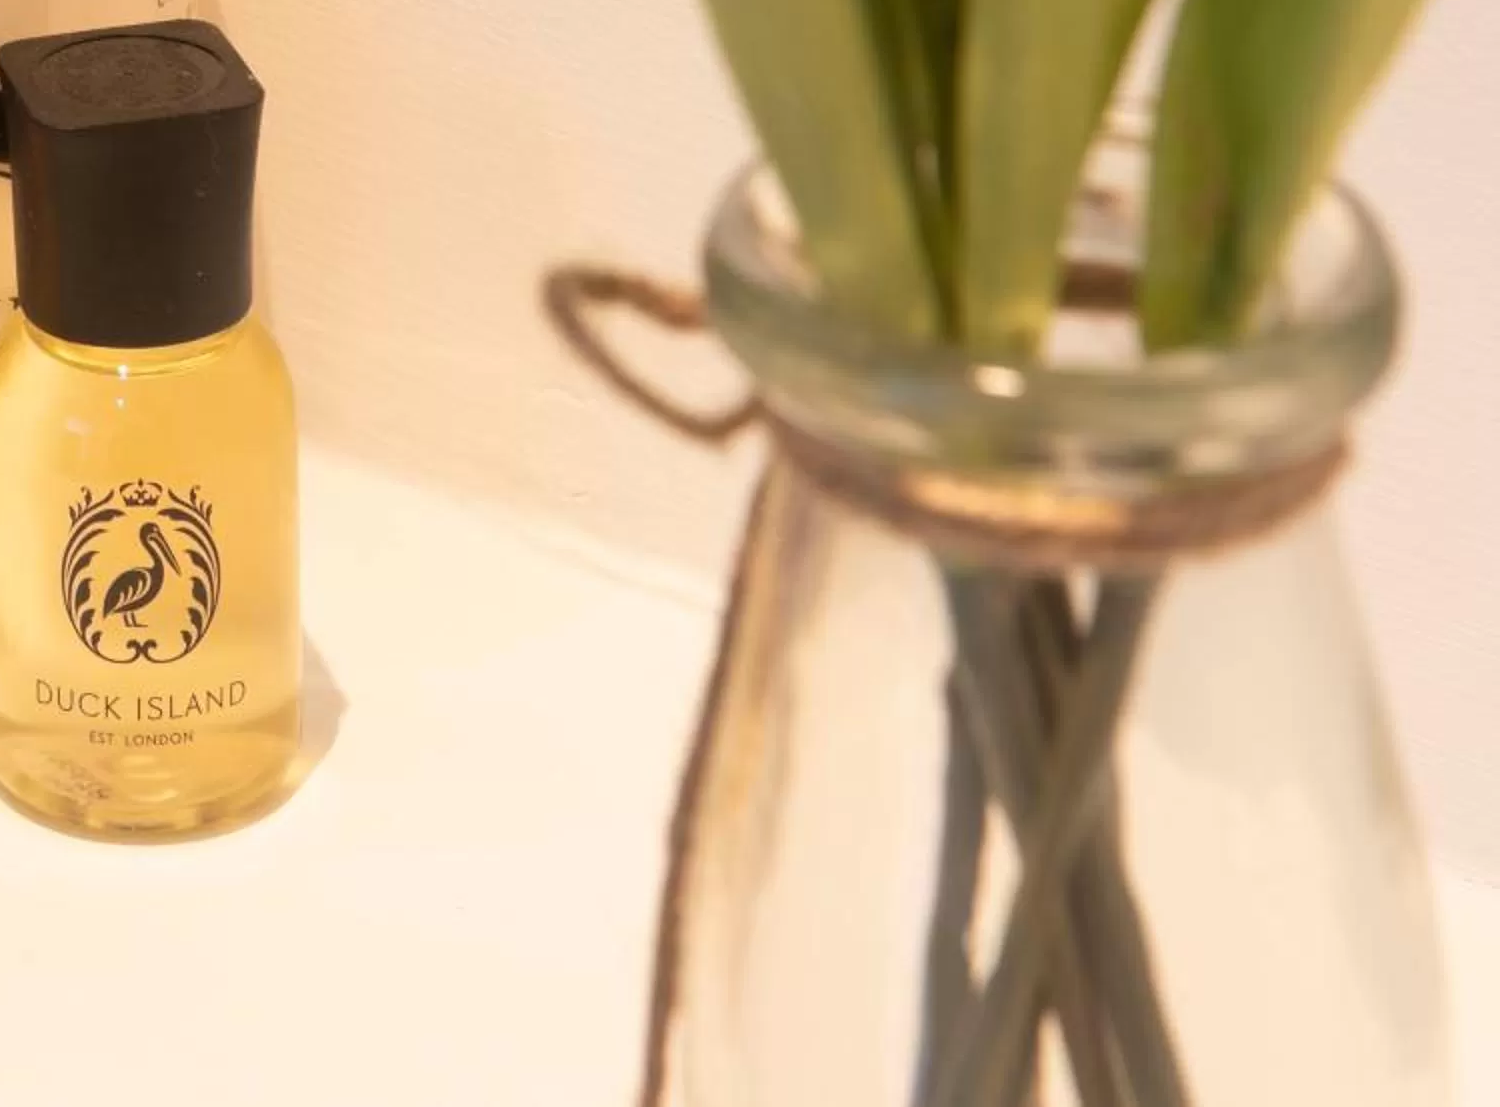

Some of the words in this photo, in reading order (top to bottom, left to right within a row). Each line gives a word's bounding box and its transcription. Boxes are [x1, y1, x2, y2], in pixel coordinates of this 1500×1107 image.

[36, 679, 122, 721] DUCK
[136, 680, 246, 721] ISLAND
[124, 730, 194, 747] LONDON
